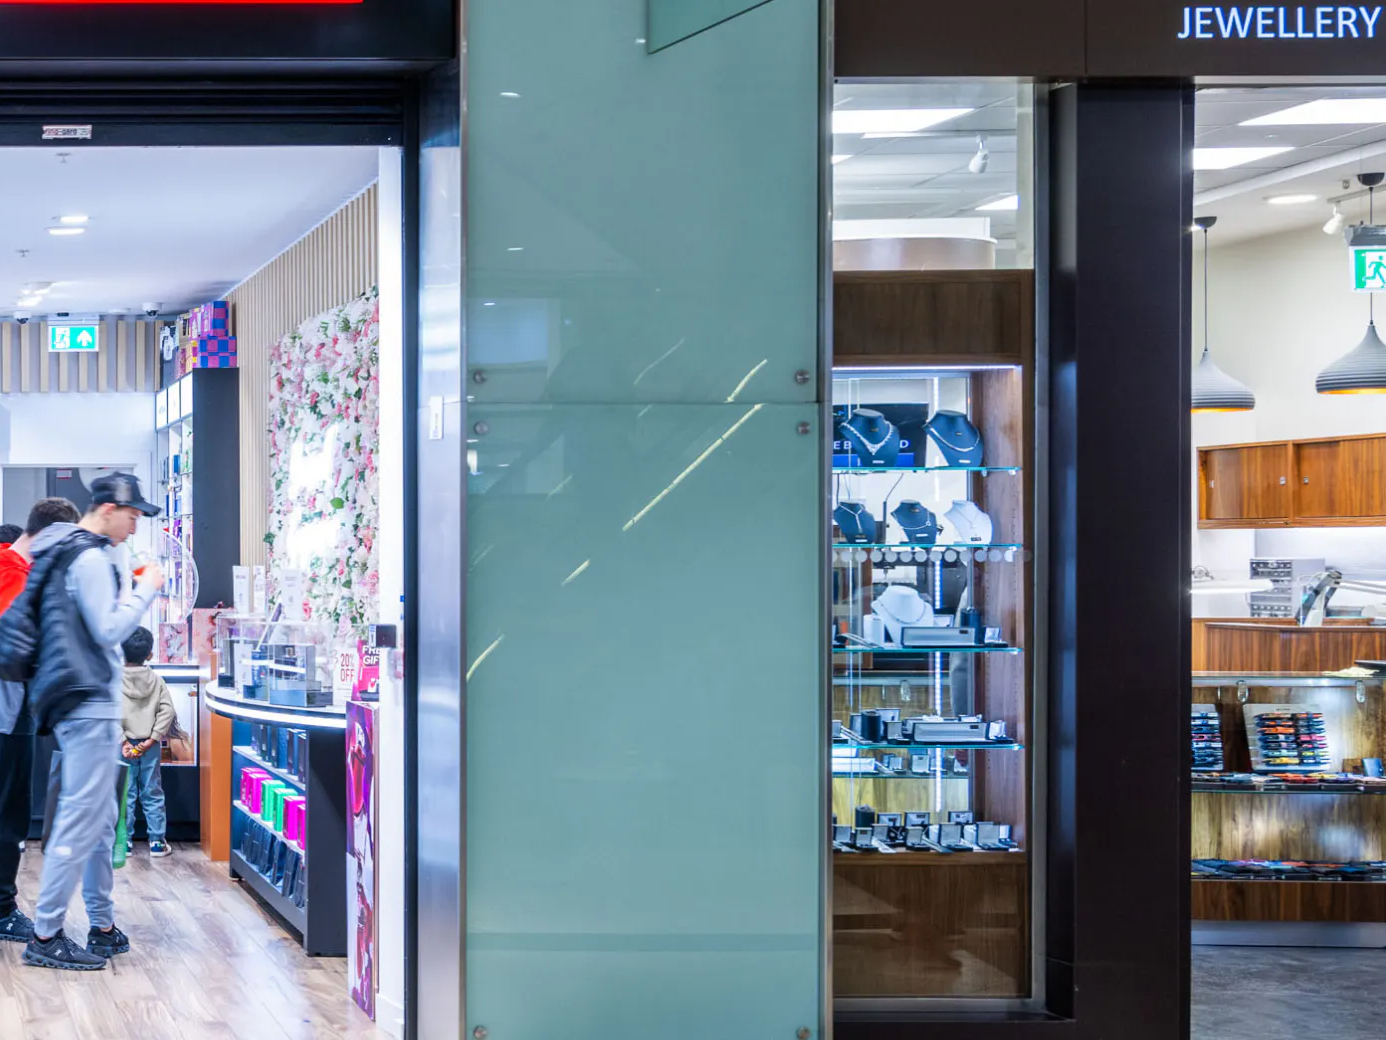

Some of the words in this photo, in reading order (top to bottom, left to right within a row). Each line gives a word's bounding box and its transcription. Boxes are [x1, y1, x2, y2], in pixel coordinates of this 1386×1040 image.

[1177, 6, 1382, 39] JEWELLERY
[362, 645, 381, 655] FRE
[362, 655, 380, 665] GIF
[340, 668, 355, 682] OFF
